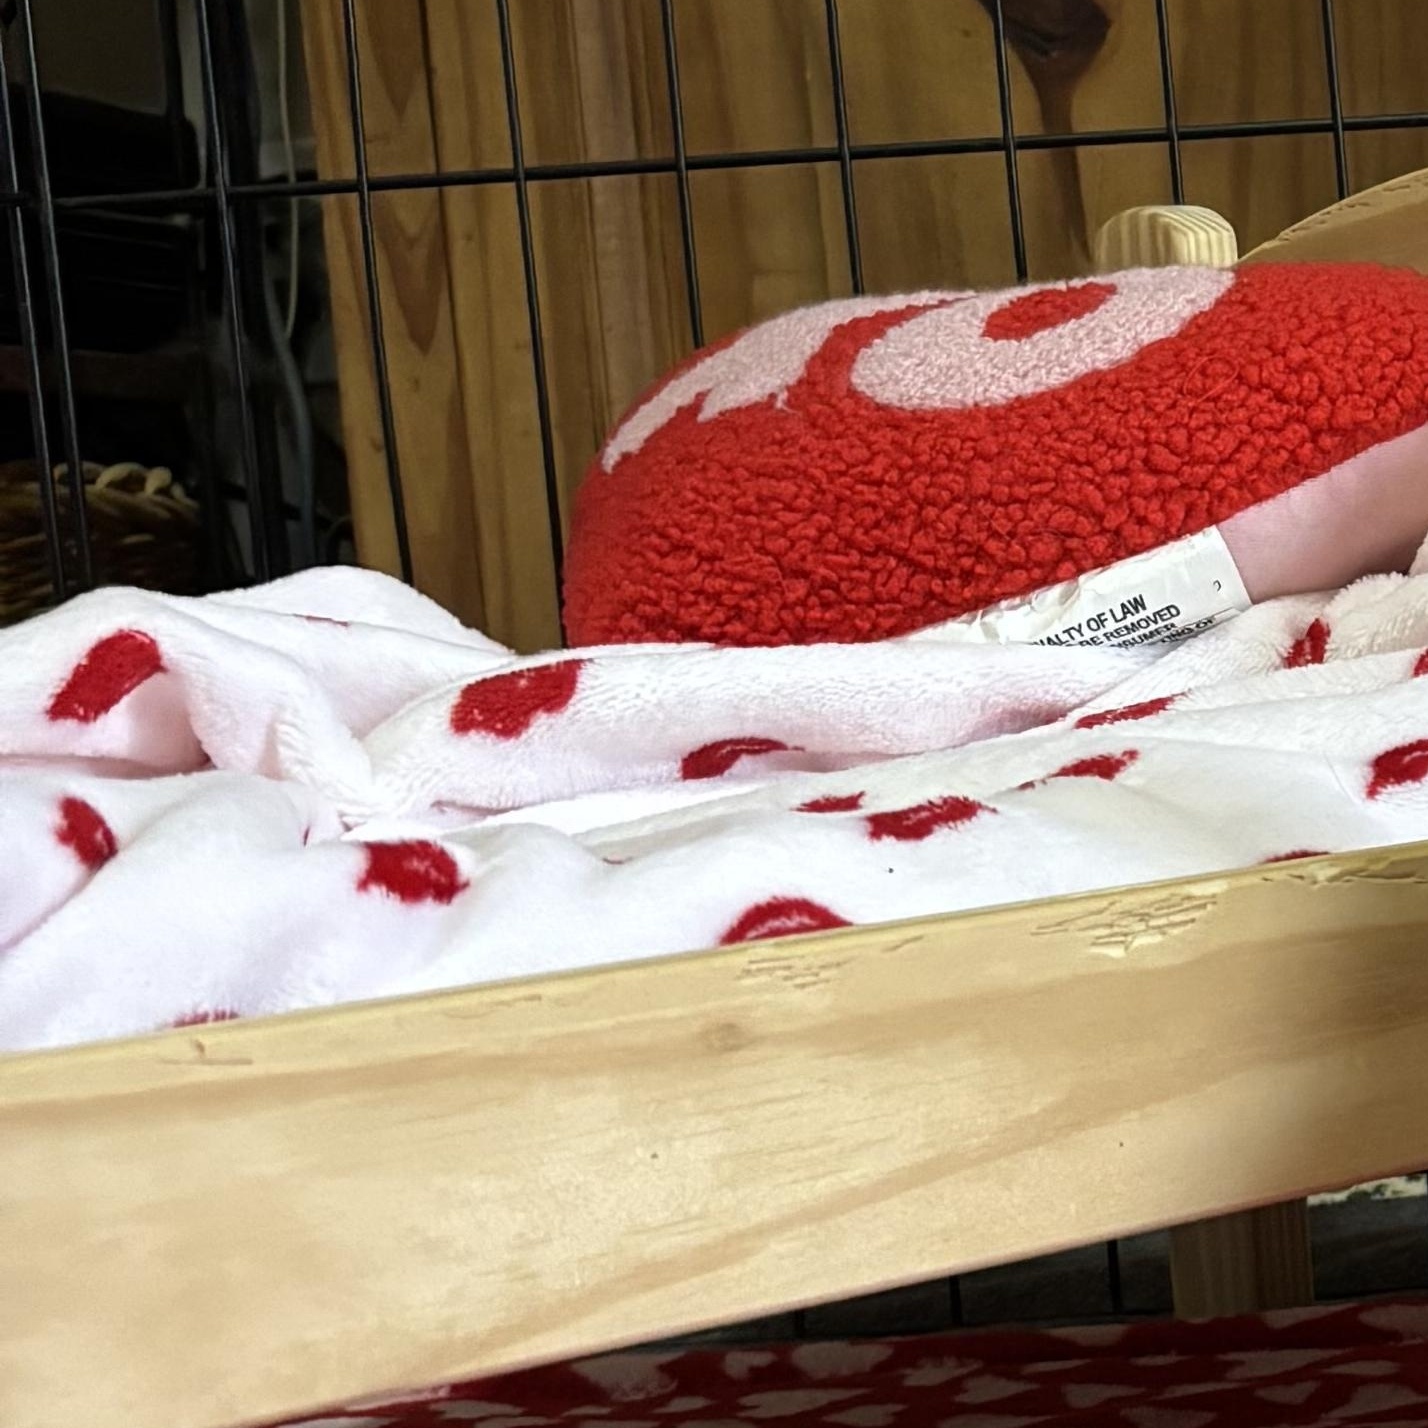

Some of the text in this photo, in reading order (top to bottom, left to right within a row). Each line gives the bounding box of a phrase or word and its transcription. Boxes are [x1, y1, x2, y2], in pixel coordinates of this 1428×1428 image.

[1034, 593, 1148, 646] ALTY OF LAW
[1103, 603, 1181, 643] REMOVED
